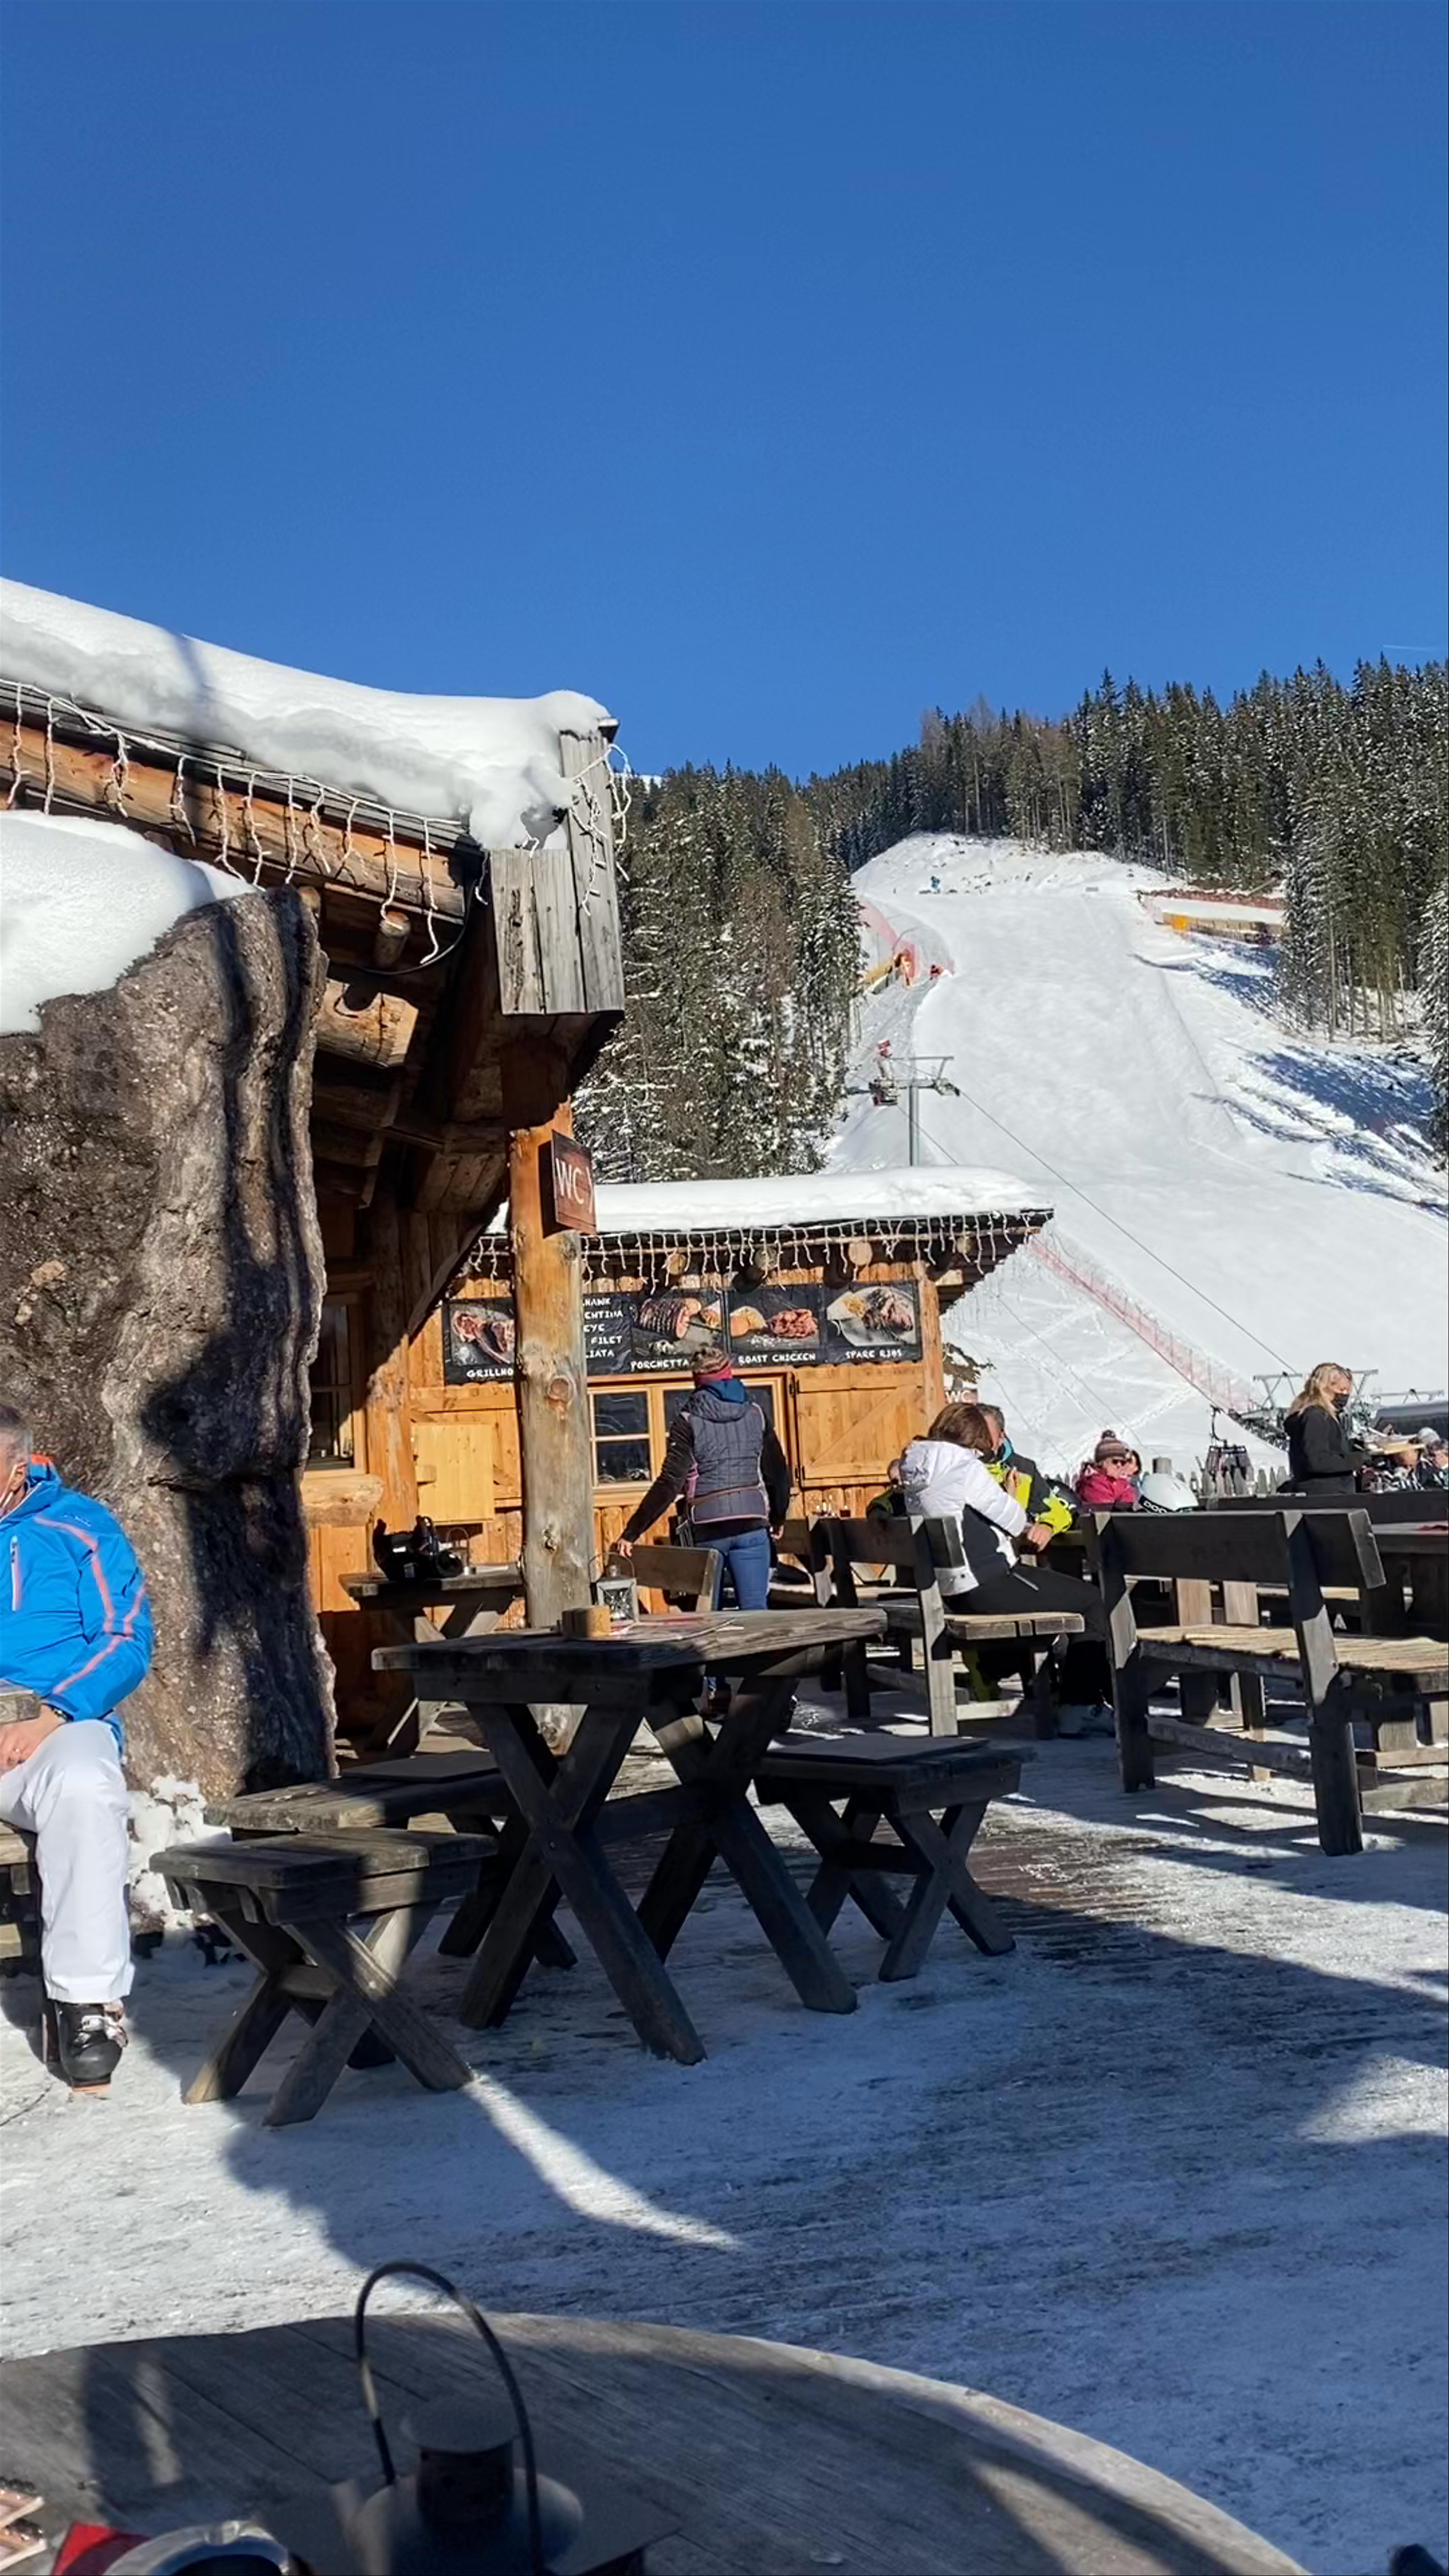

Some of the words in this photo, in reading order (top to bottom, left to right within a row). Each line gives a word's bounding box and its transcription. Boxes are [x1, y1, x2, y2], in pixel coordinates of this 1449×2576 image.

[555, 1157, 584, 1204] WC
[583, 1298, 610, 1306] HAWK
[585, 1349, 614, 1358] IATA
[738, 1354, 768, 1364] ROAST
[772, 1353, 816, 1362] CHICKEN
[846, 1350, 875, 1359] SPARE
[879, 1349, 902, 1358] RIBS
[631, 1359, 689, 1372] PORCHETTA
[945, 1390, 972, 1403] WC
